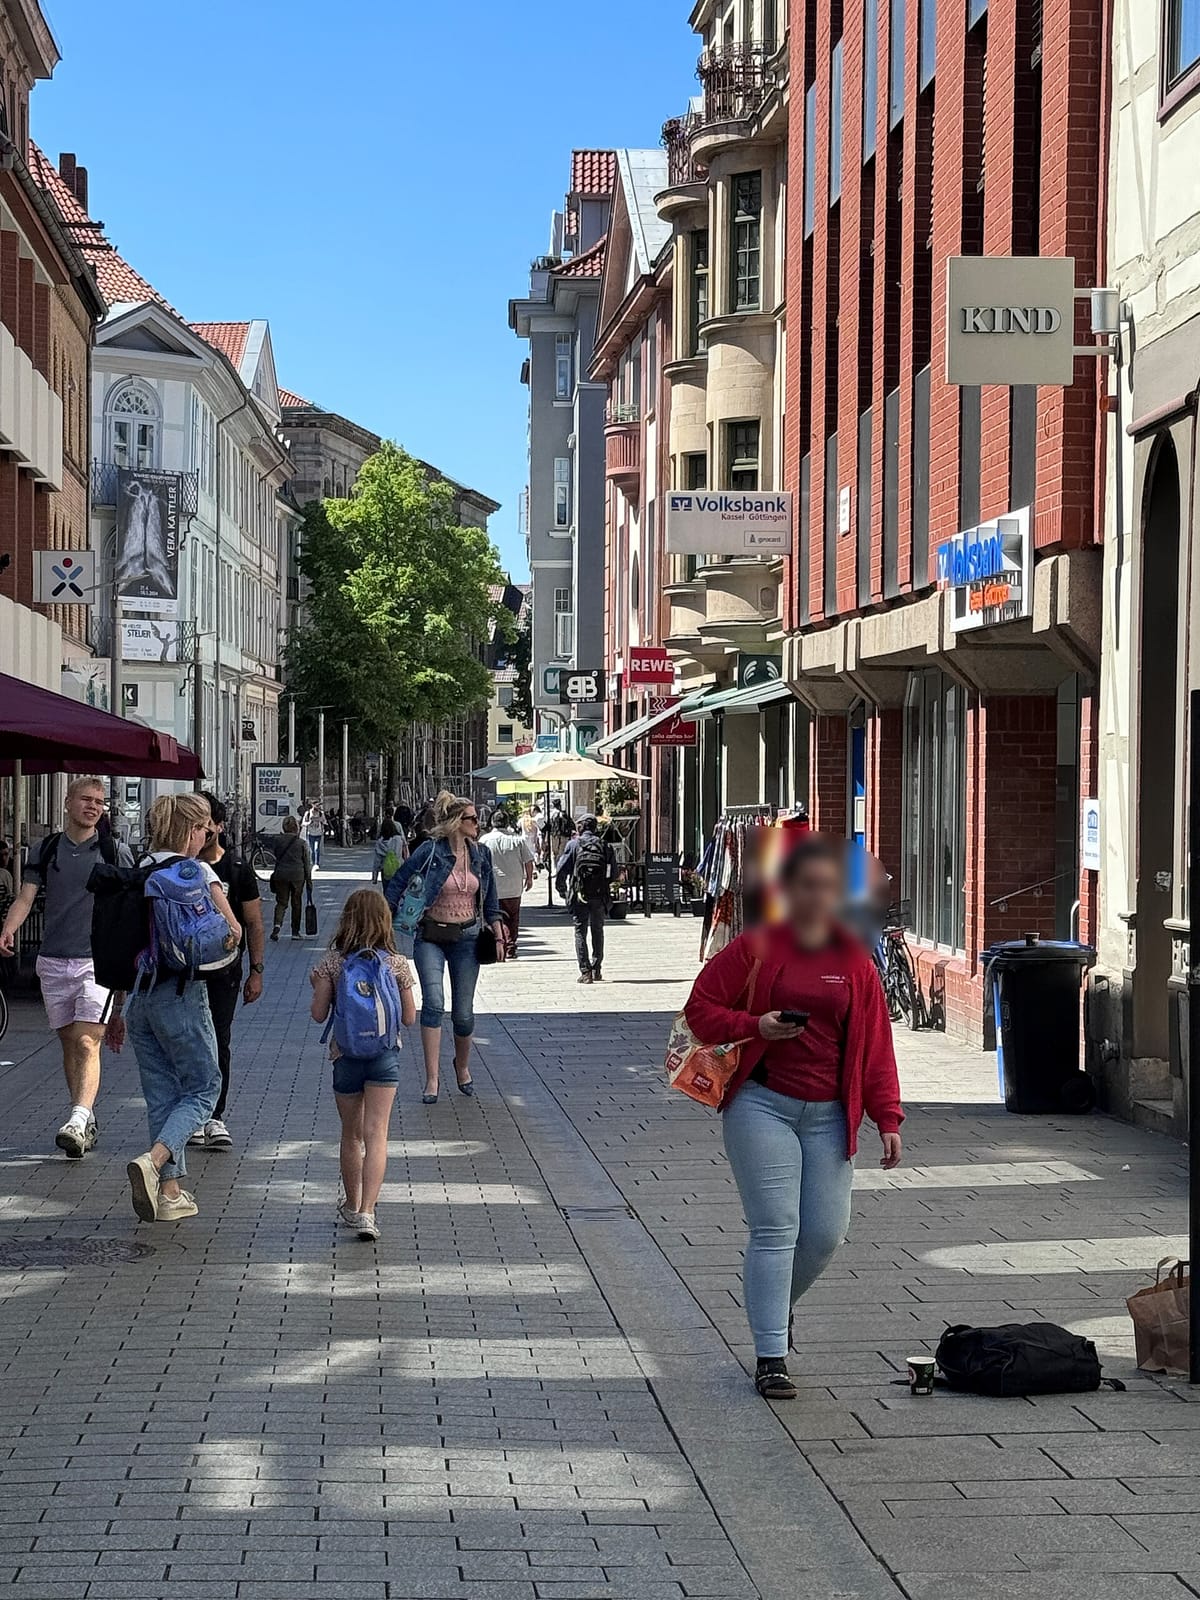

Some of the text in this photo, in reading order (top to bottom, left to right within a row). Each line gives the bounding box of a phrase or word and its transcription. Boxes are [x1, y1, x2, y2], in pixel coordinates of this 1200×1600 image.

[961, 306, 1062, 334] KIND
[696, 496, 787, 512] Volksbank
[167, 486, 177, 558] VERA KATTLER
[721, 512, 787, 522] Kassel Göttingen
[631, 659, 675, 672] REWE
[258, 769, 282, 778] NOW
[258, 777, 281, 785] ERST
